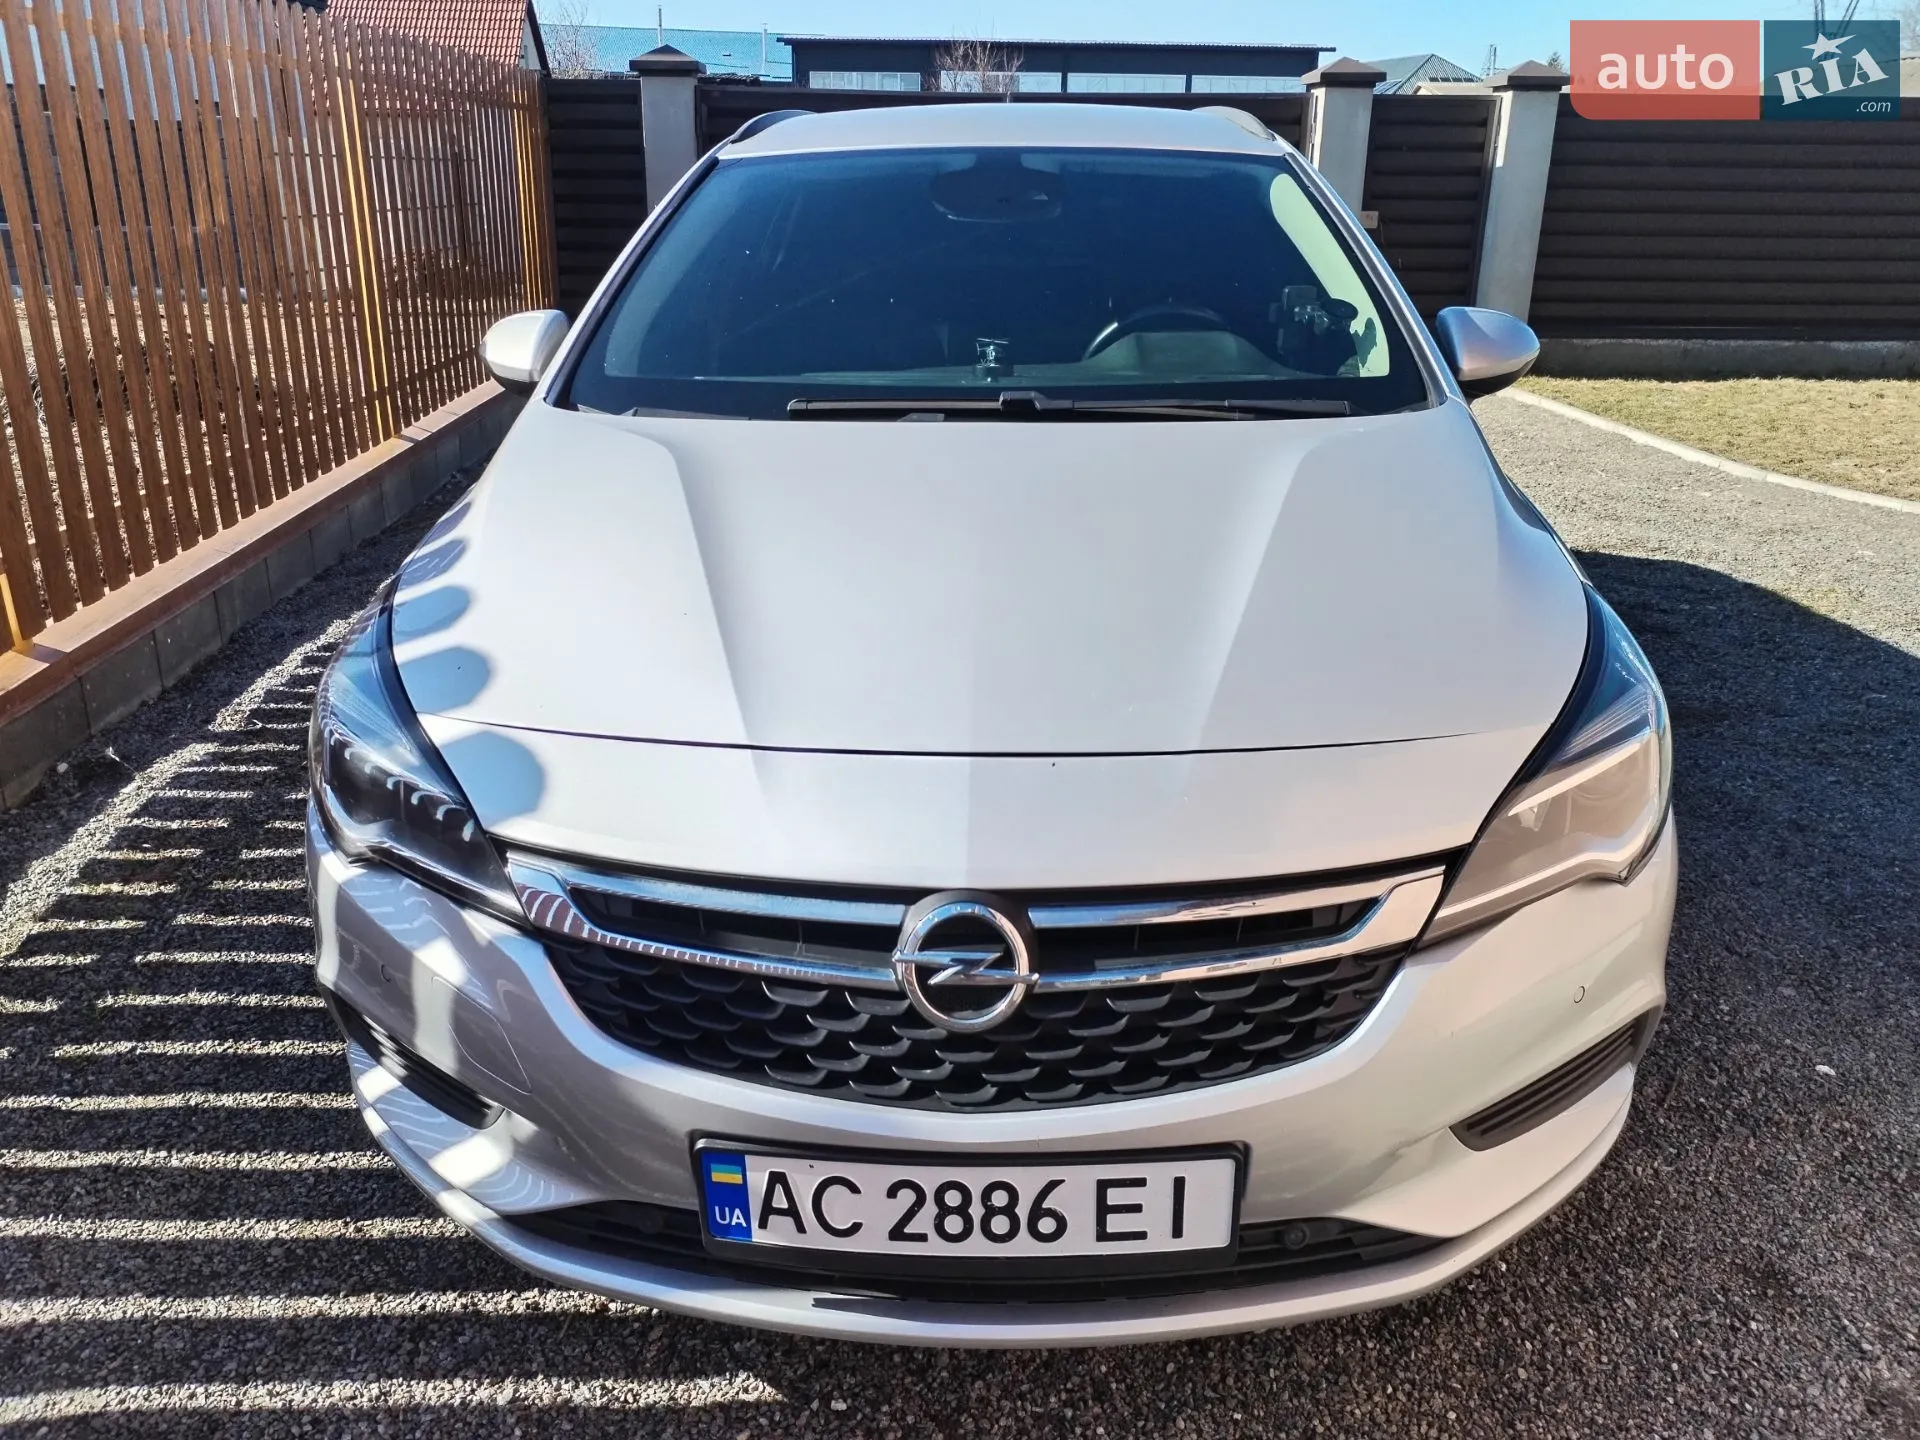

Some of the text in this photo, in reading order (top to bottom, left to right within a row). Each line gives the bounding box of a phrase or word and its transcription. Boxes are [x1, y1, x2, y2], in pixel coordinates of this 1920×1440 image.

[715, 1205, 747, 1228] UA
[758, 1170, 1186, 1244] AC 2886 EI
